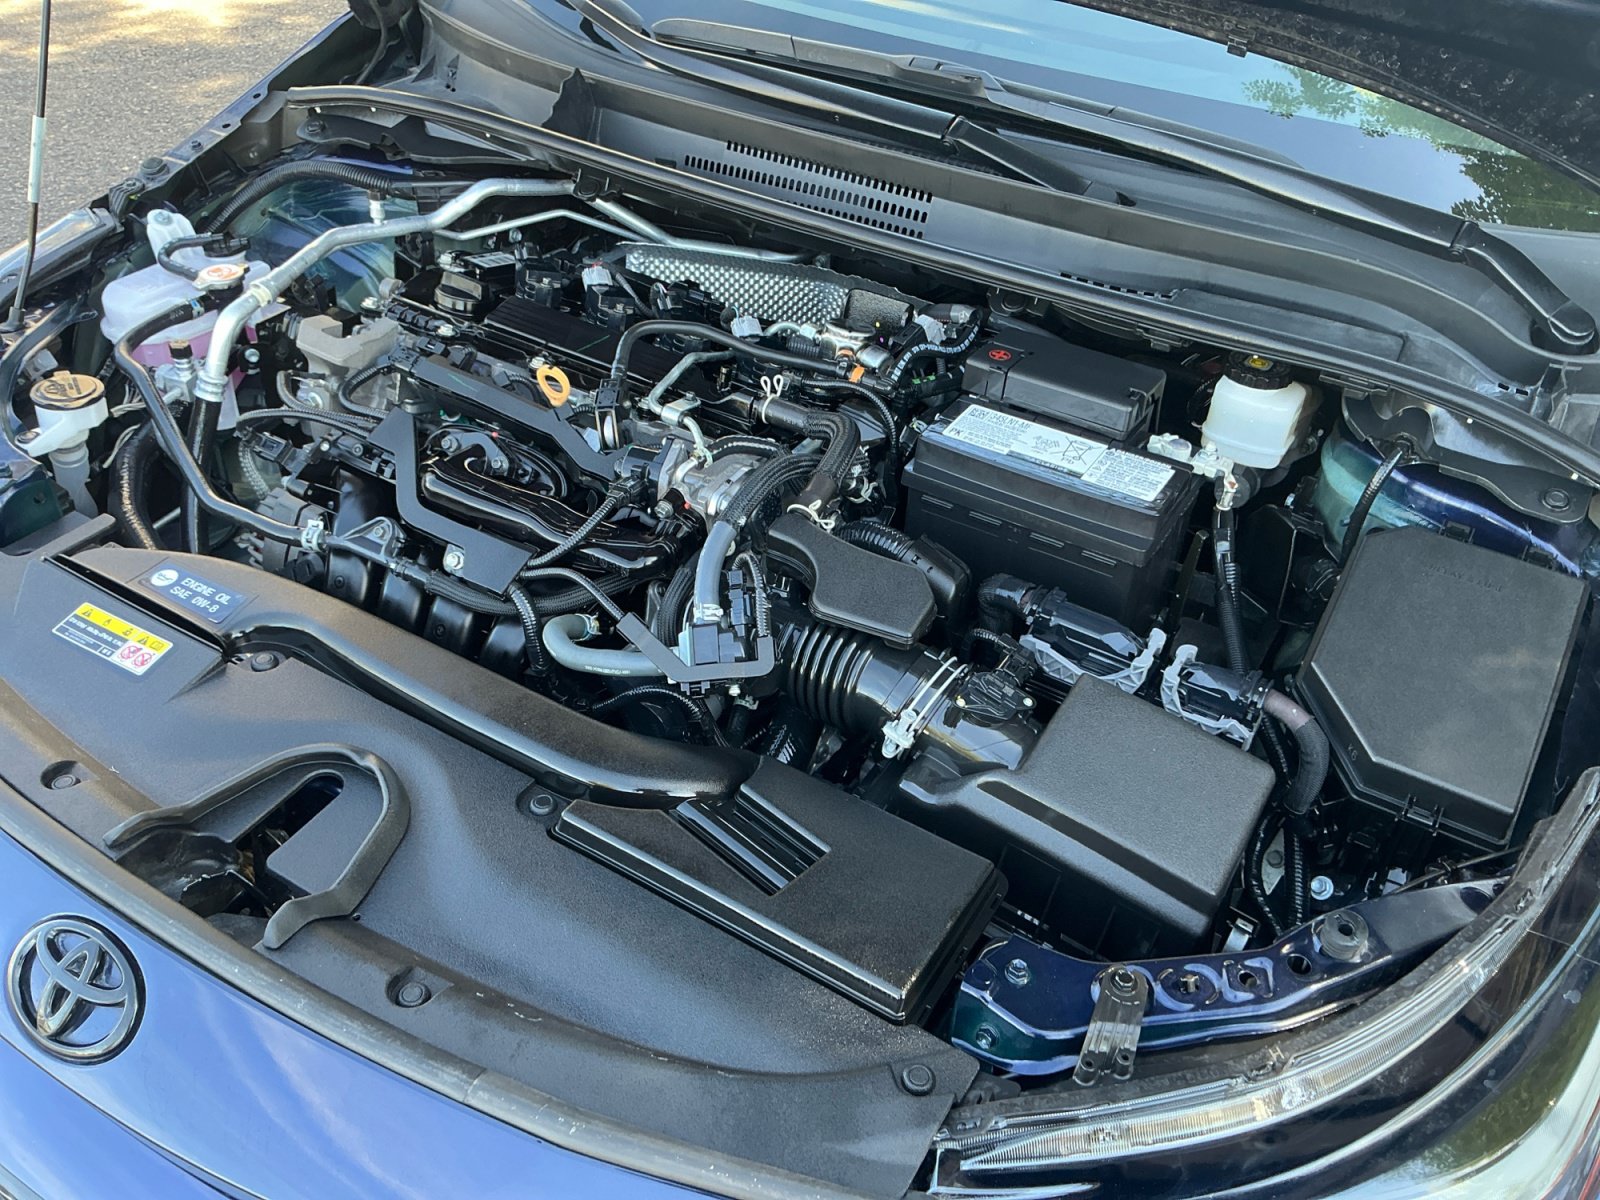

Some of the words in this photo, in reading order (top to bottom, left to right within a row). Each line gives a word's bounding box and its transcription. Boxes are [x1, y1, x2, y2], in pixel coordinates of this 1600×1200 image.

[169, 586, 192, 599] SAE
[191, 595, 220, 613] 0W-8
[180, 577, 217, 597] ENGINE
[215, 592, 232, 605] OIL
